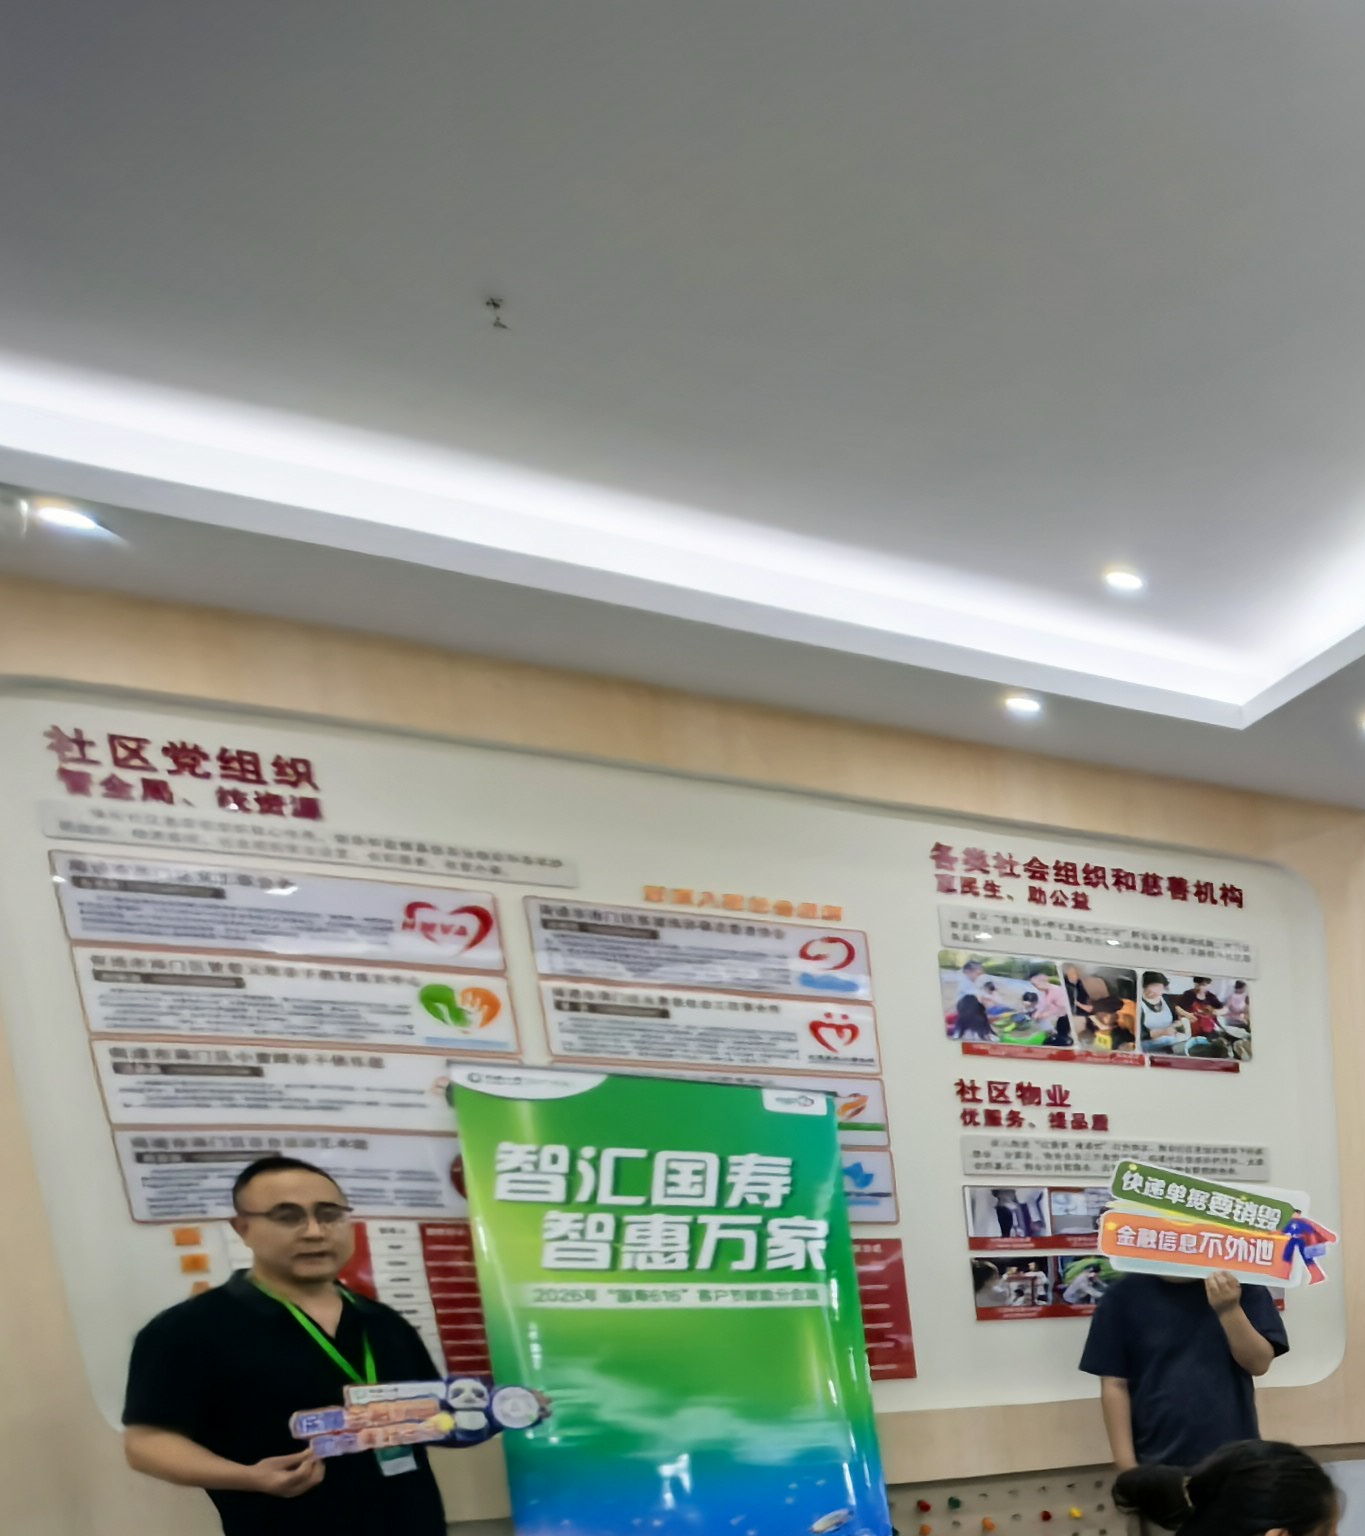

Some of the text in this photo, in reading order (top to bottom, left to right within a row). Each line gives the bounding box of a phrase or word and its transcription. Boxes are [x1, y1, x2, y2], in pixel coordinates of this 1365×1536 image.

[43, 724, 320, 791] 社区党组织
[930, 842, 1245, 909] 各类社会组织和慈善机构
[954, 1079, 1072, 1107] 社区物业
[494, 1142, 792, 1208] 智汇国寿
[1121, 1170, 1282, 1232] 快递单据要销毁
[542, 1211, 829, 1271] 智惠万家
[1116, 1225, 1275, 1266] 金融信息不外泄
